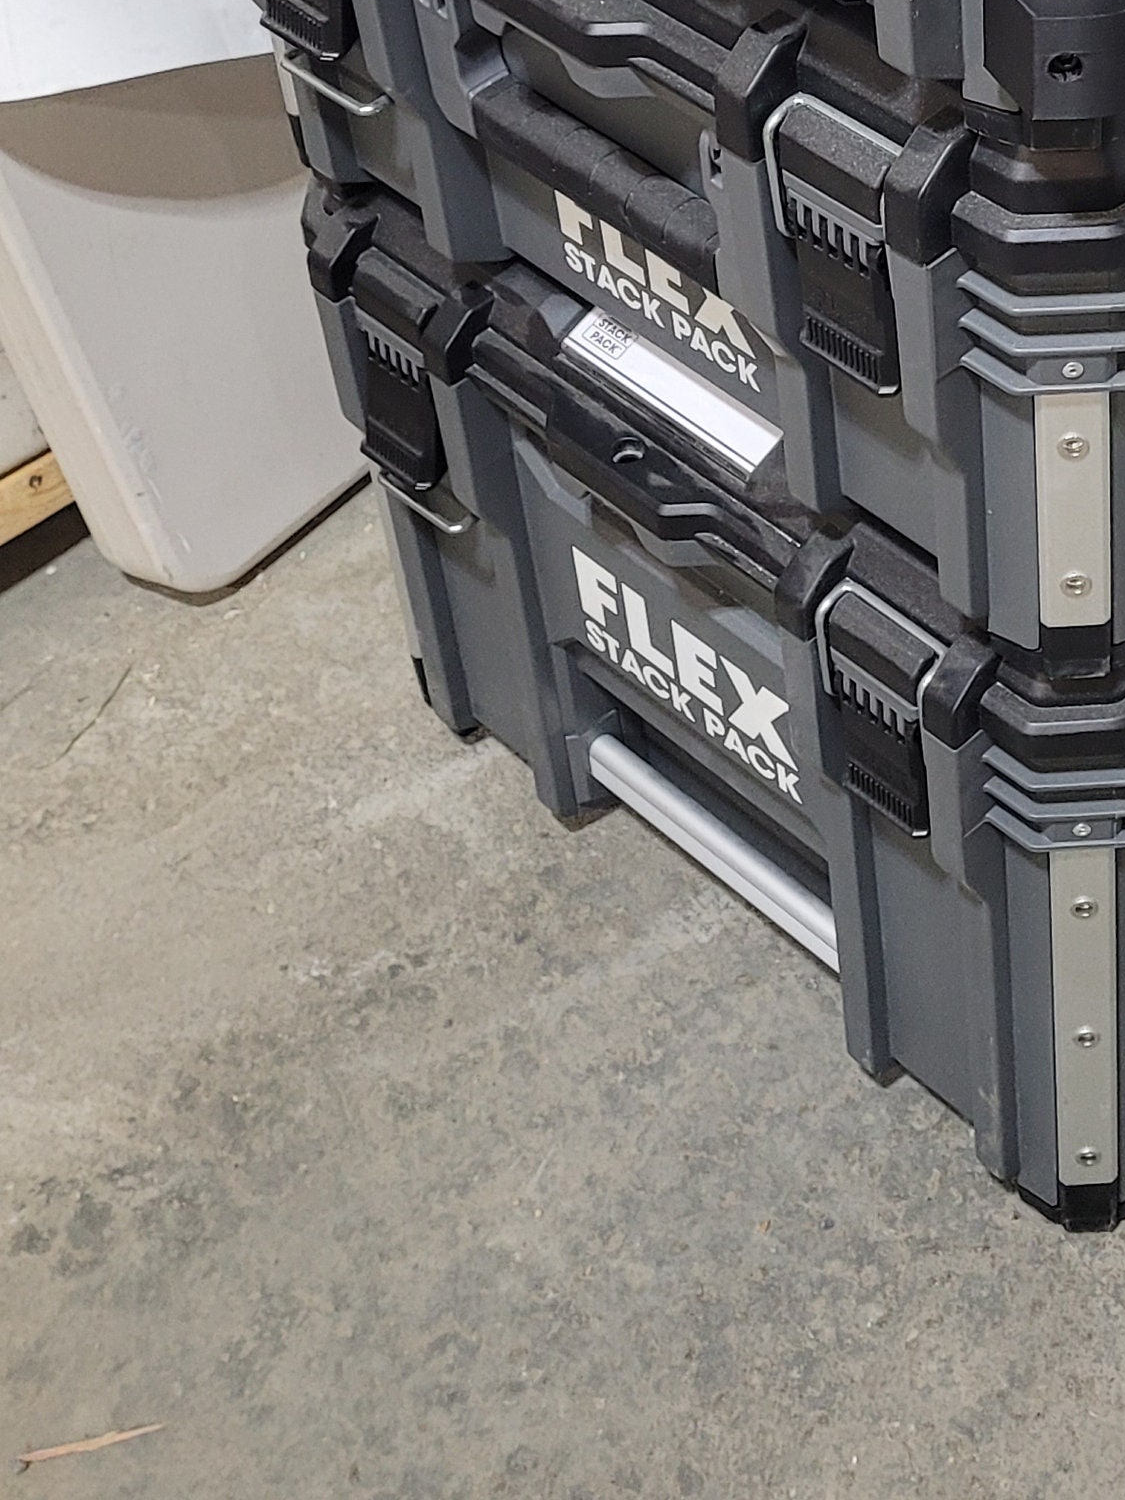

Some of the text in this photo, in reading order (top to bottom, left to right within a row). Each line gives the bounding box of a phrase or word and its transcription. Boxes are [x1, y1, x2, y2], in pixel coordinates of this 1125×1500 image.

[563, 241, 666, 329] STACK
[671, 310, 761, 393] PACK
[590, 331, 621, 354] PACK
[598, 318, 632, 344] STACK
[571, 545, 799, 773] FLEX
[584, 619, 803, 805] STACK PACK
